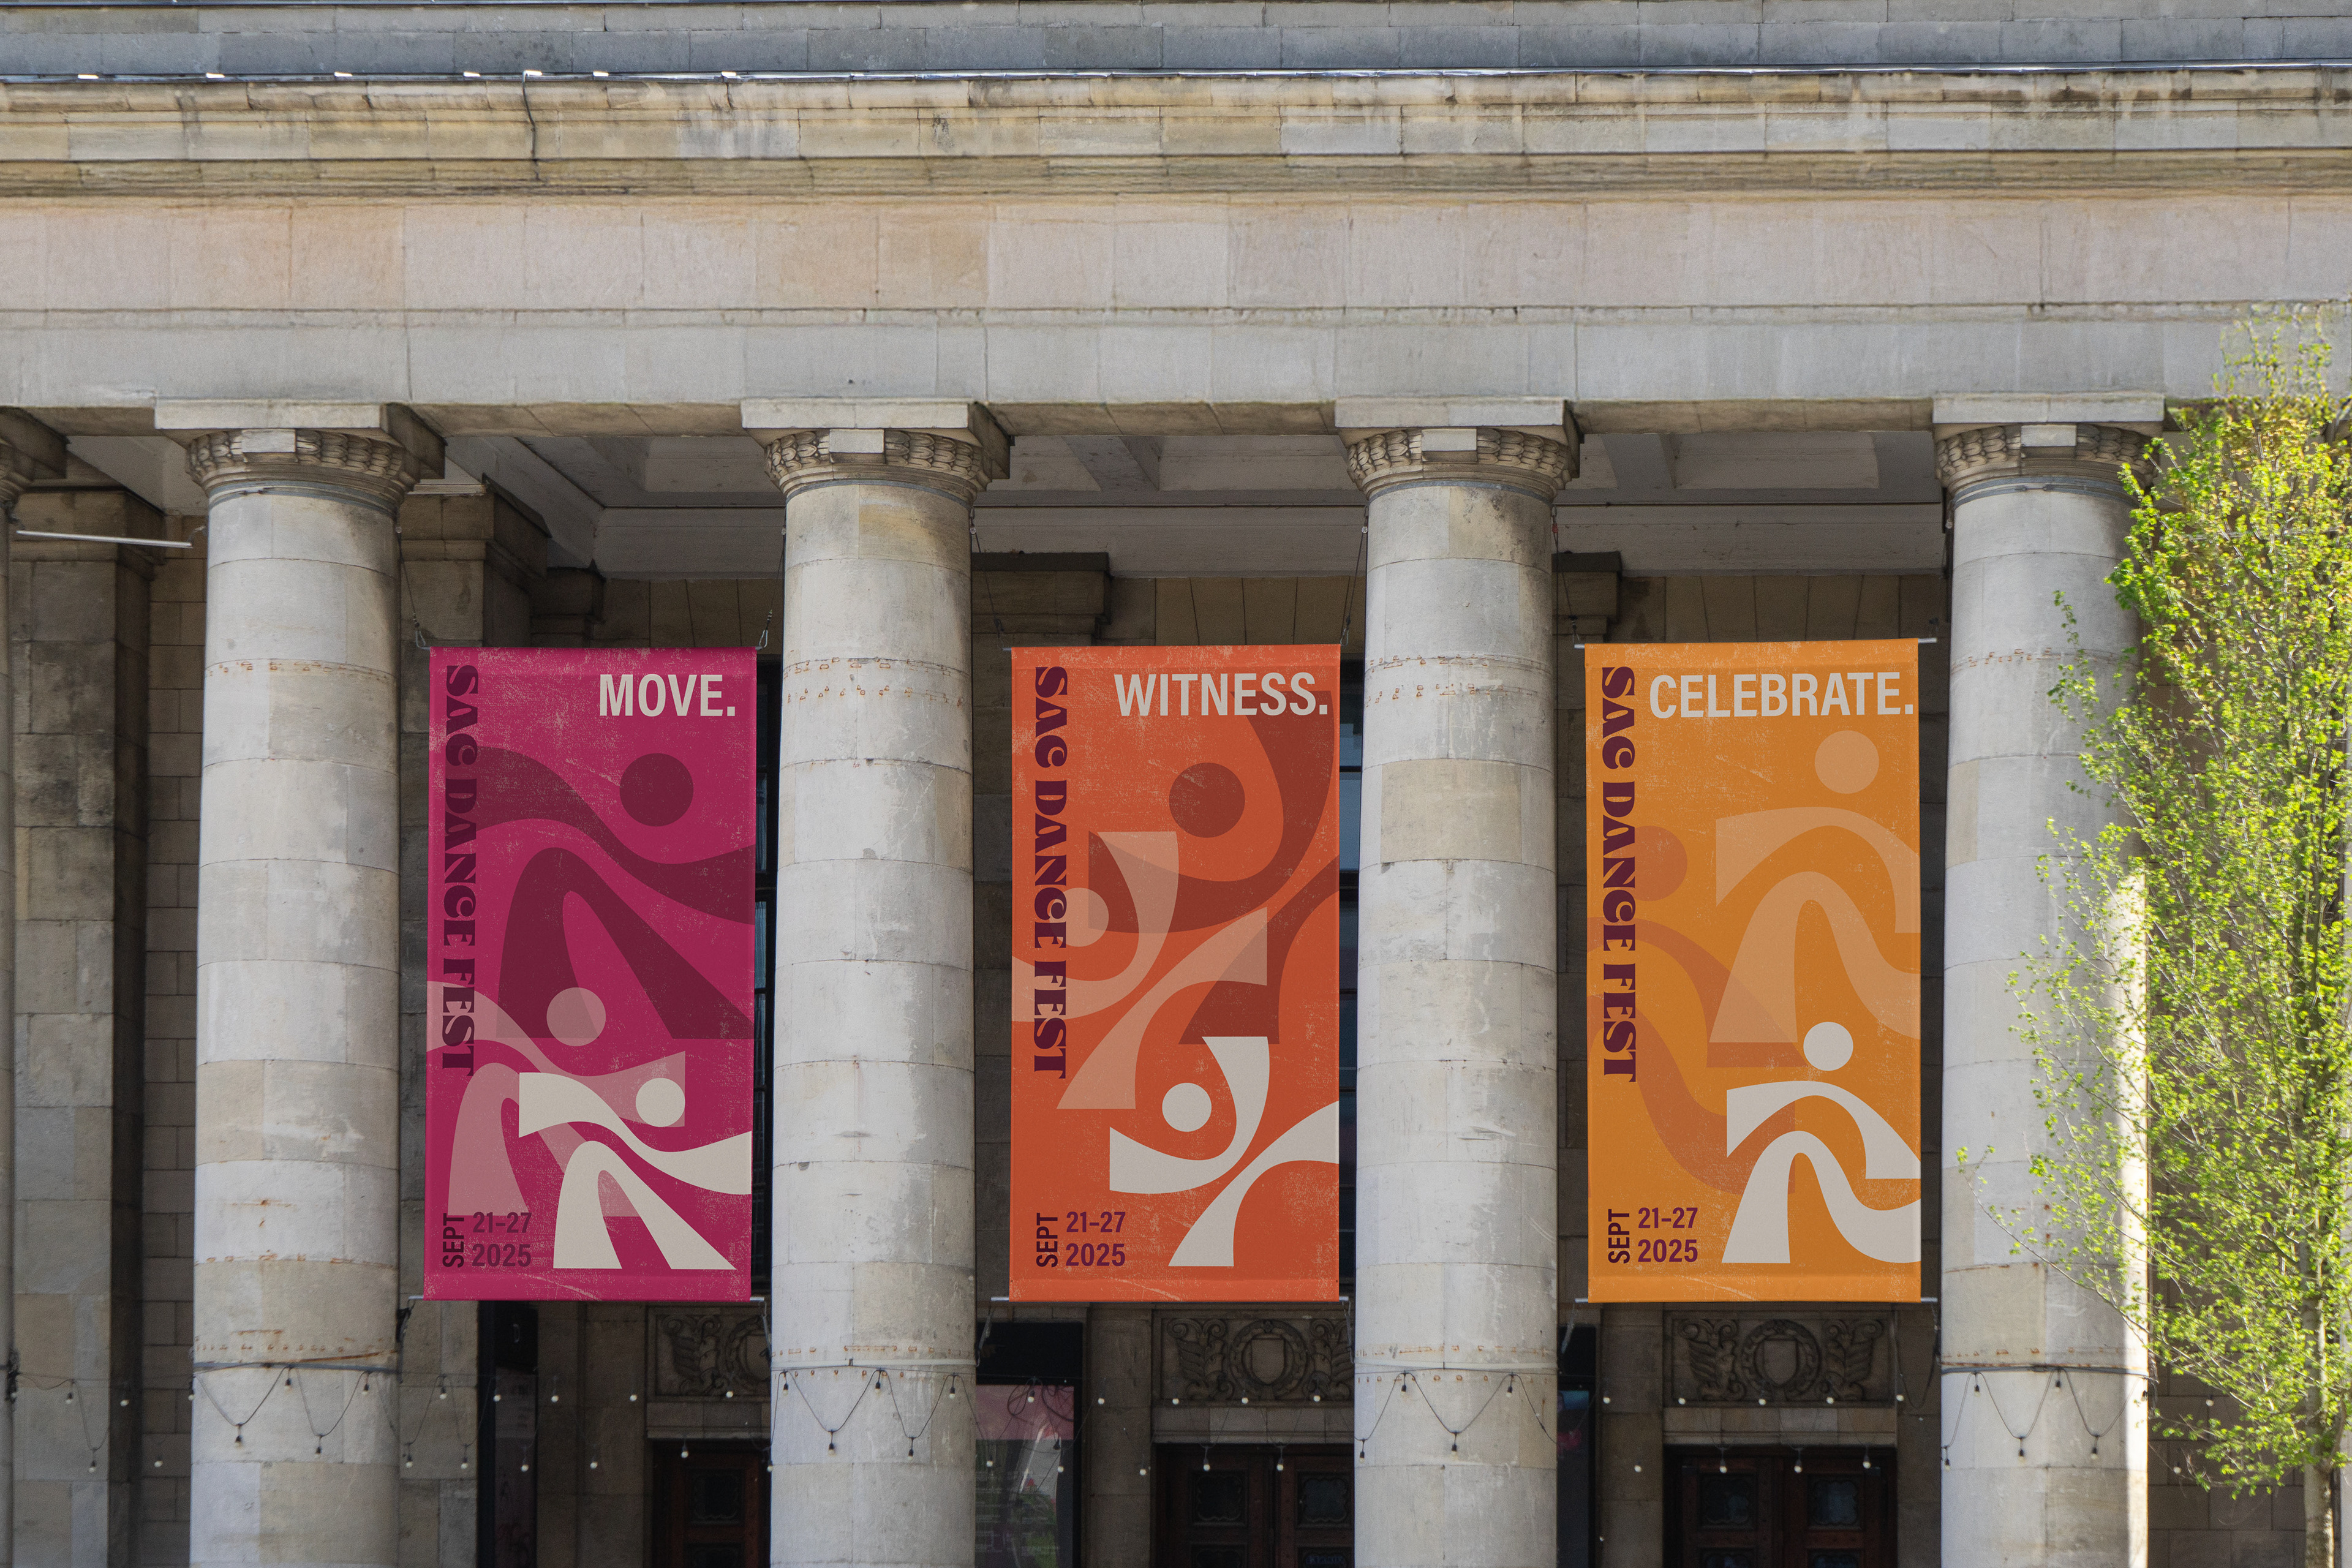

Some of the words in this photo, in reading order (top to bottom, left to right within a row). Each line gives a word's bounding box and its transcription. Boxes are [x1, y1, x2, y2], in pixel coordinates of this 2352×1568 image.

[445, 664, 478, 768] SAC
[598, 674, 736, 717] MOVE.
[1034, 666, 1068, 769] SAC
[1113, 671, 1329, 717] WITNESS.
[1602, 666, 1635, 770] SAC
[1648, 671, 1915, 719] CELEBRATE.
[443, 777, 478, 947] DANCE
[1034, 779, 1068, 949] DANCE
[1602, 781, 1637, 952] DANCE
[442, 958, 476, 1076] FEST
[1033, 960, 1066, 1079] FEST
[1603, 963, 1637, 1083] FEST
[442, 1212, 466, 1268] SEPT
[470, 1243, 532, 1268] 2025
[1035, 1212, 1058, 1268] SEPT
[1065, 1243, 1126, 1268] 2025
[1607, 1208, 1630, 1264] SEPT
[1637, 1238, 1699, 1264] 2025
